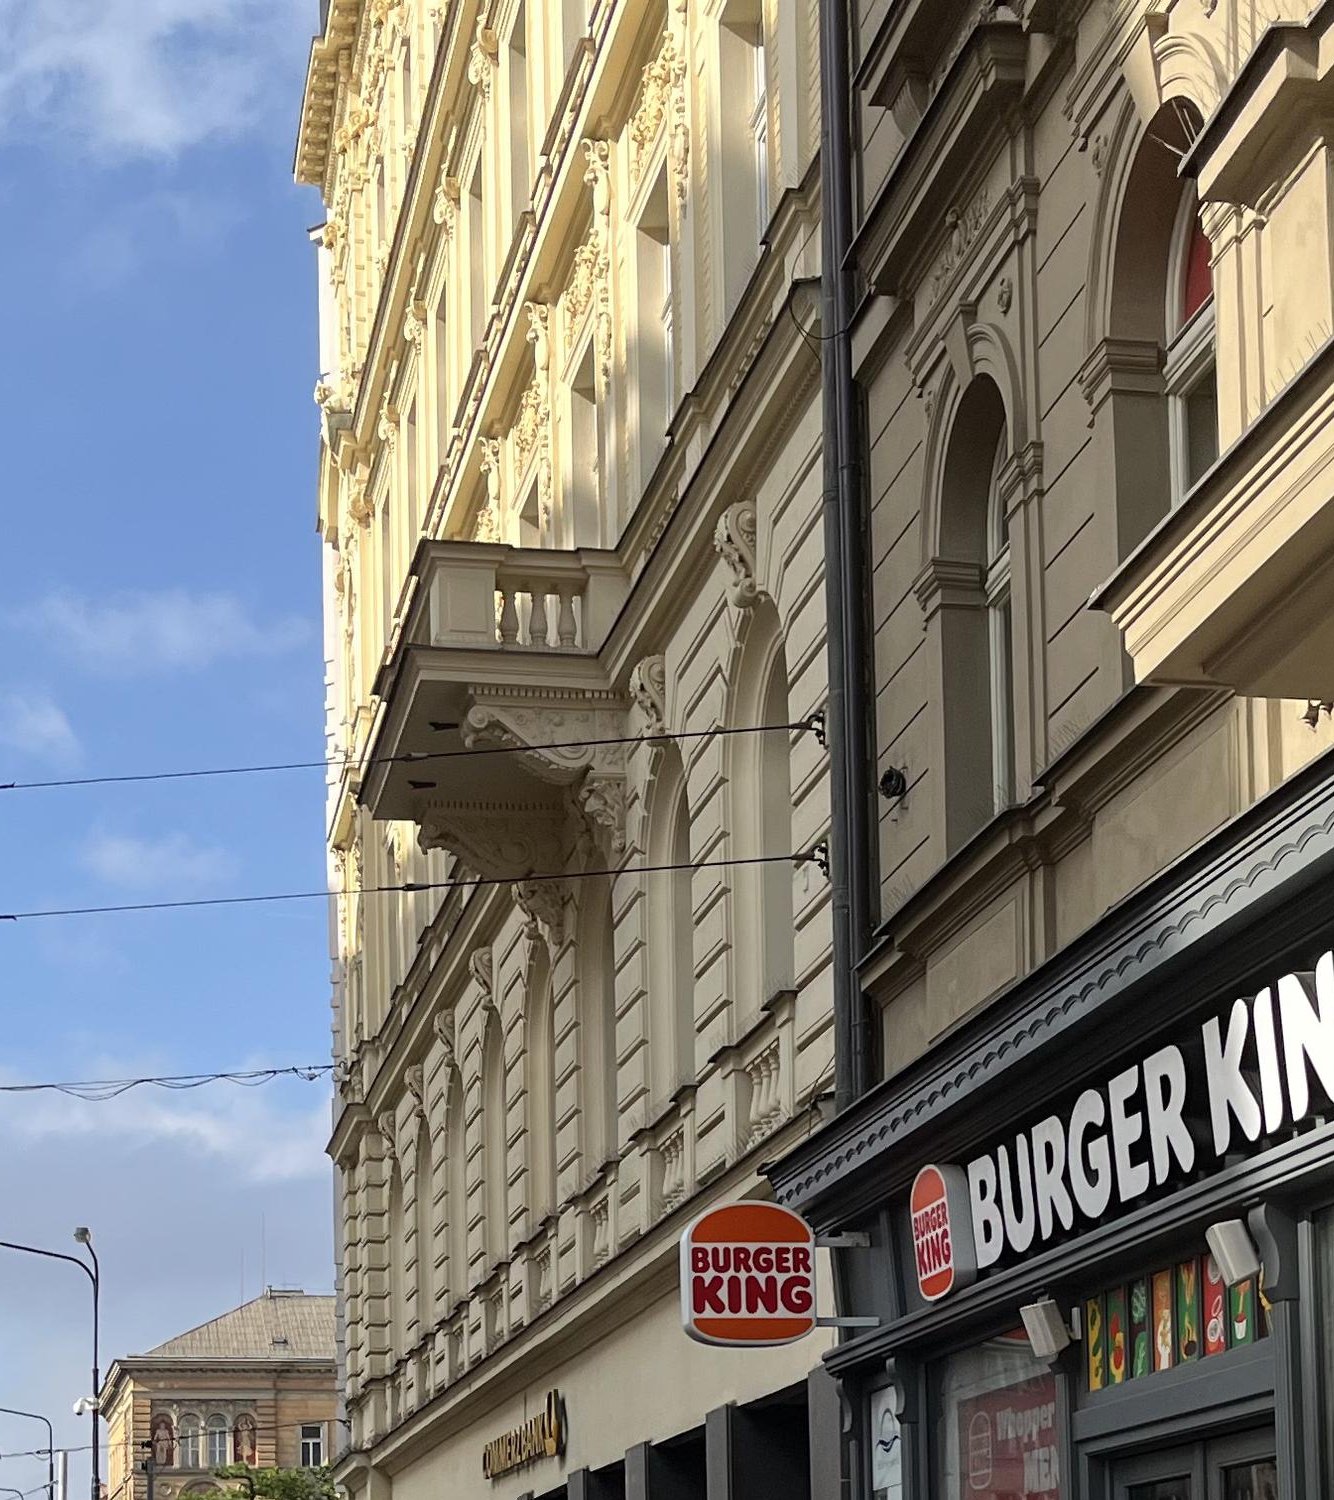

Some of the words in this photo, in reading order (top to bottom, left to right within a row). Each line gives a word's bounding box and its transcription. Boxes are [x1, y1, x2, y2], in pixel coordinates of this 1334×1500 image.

[967, 1044, 1196, 1270] BURGER
[913, 1201, 948, 1238] BURGER
[691, 1247, 812, 1274] BURGER
[917, 1228, 951, 1278] KING
[692, 1275, 813, 1314] KING
[996, 1401, 1055, 1443] Whopper
[483, 1411, 547, 1479] COMMERZBANK
